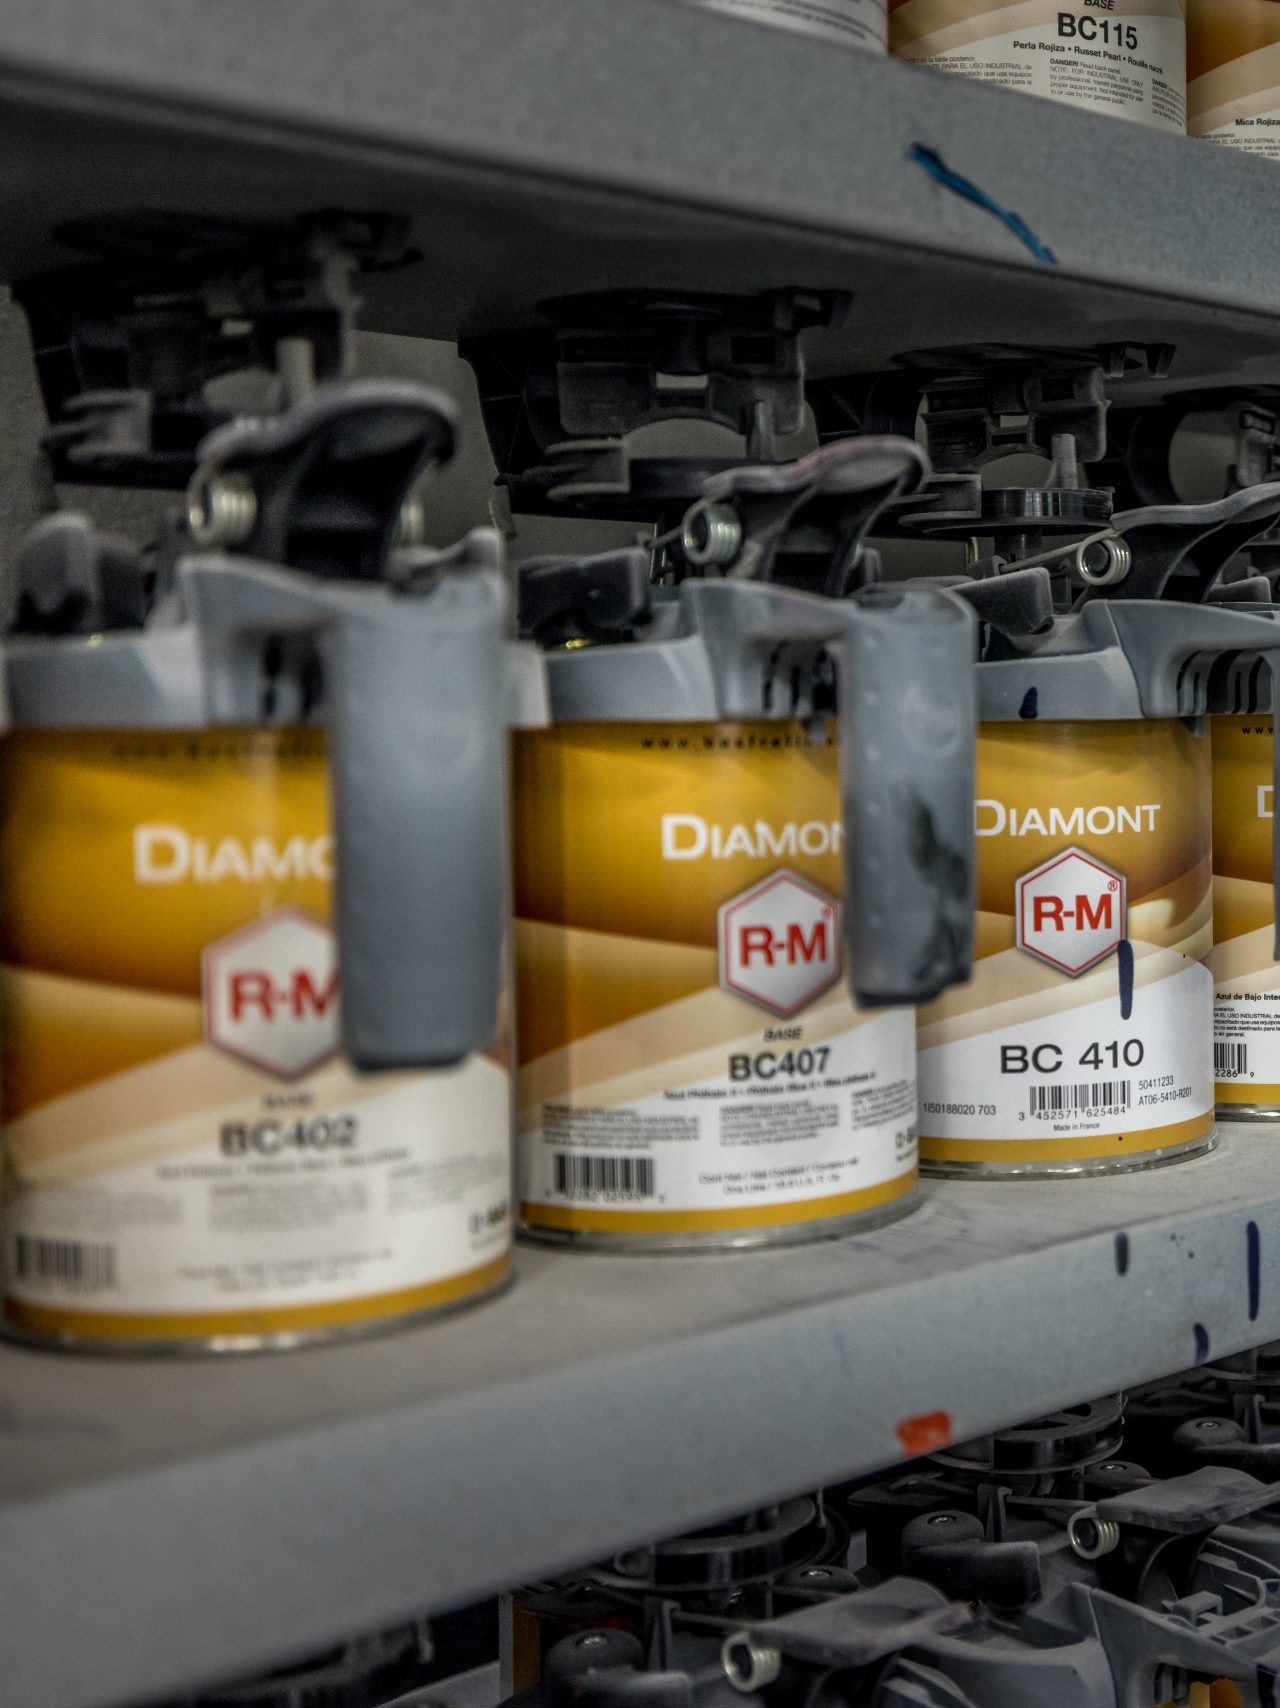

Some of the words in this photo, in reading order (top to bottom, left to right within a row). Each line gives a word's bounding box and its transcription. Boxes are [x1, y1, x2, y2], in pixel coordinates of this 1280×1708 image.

[1057, 12, 1138, 50] BC115
[1013, 40, 1037, 51] Perla
[1038, 42, 1065, 53] Rojiza
[1074, 46, 1102, 58] Russet
[1103, 50, 1122, 62] Pearl
[1256, 118, 1280, 127] Rojiza
[974, 799, 1161, 836] DIAMONT
[133, 822, 335, 884] DIAMO
[1033, 894, 1112, 932] R-M
[738, 922, 829, 968] R-M
[228, 968, 338, 1025] R-M
[1244, 993, 1261, 1001] Bajo
[763, 1026, 803, 1042] BASE
[728, 1046, 832, 1082] BC407
[1000, 1043, 1063, 1075] BC
[1078, 1038, 1144, 1070] 410
[1138, 1075, 1174, 1091] 50411233
[1215, 1069, 1238, 1078] 2286
[1138, 1086, 1192, 1106] AT06-5410-R201
[978, 1104, 997, 1116] 703
[1018, 1111, 1025, 1121] 3
[1035, 1110, 1078, 1121] 452571
[1086, 1106, 1126, 1119] 625484
[218, 1113, 358, 1158] BC402
[1053, 1123, 1071, 1132] Made
[1079, 1121, 1100, 1131] France
